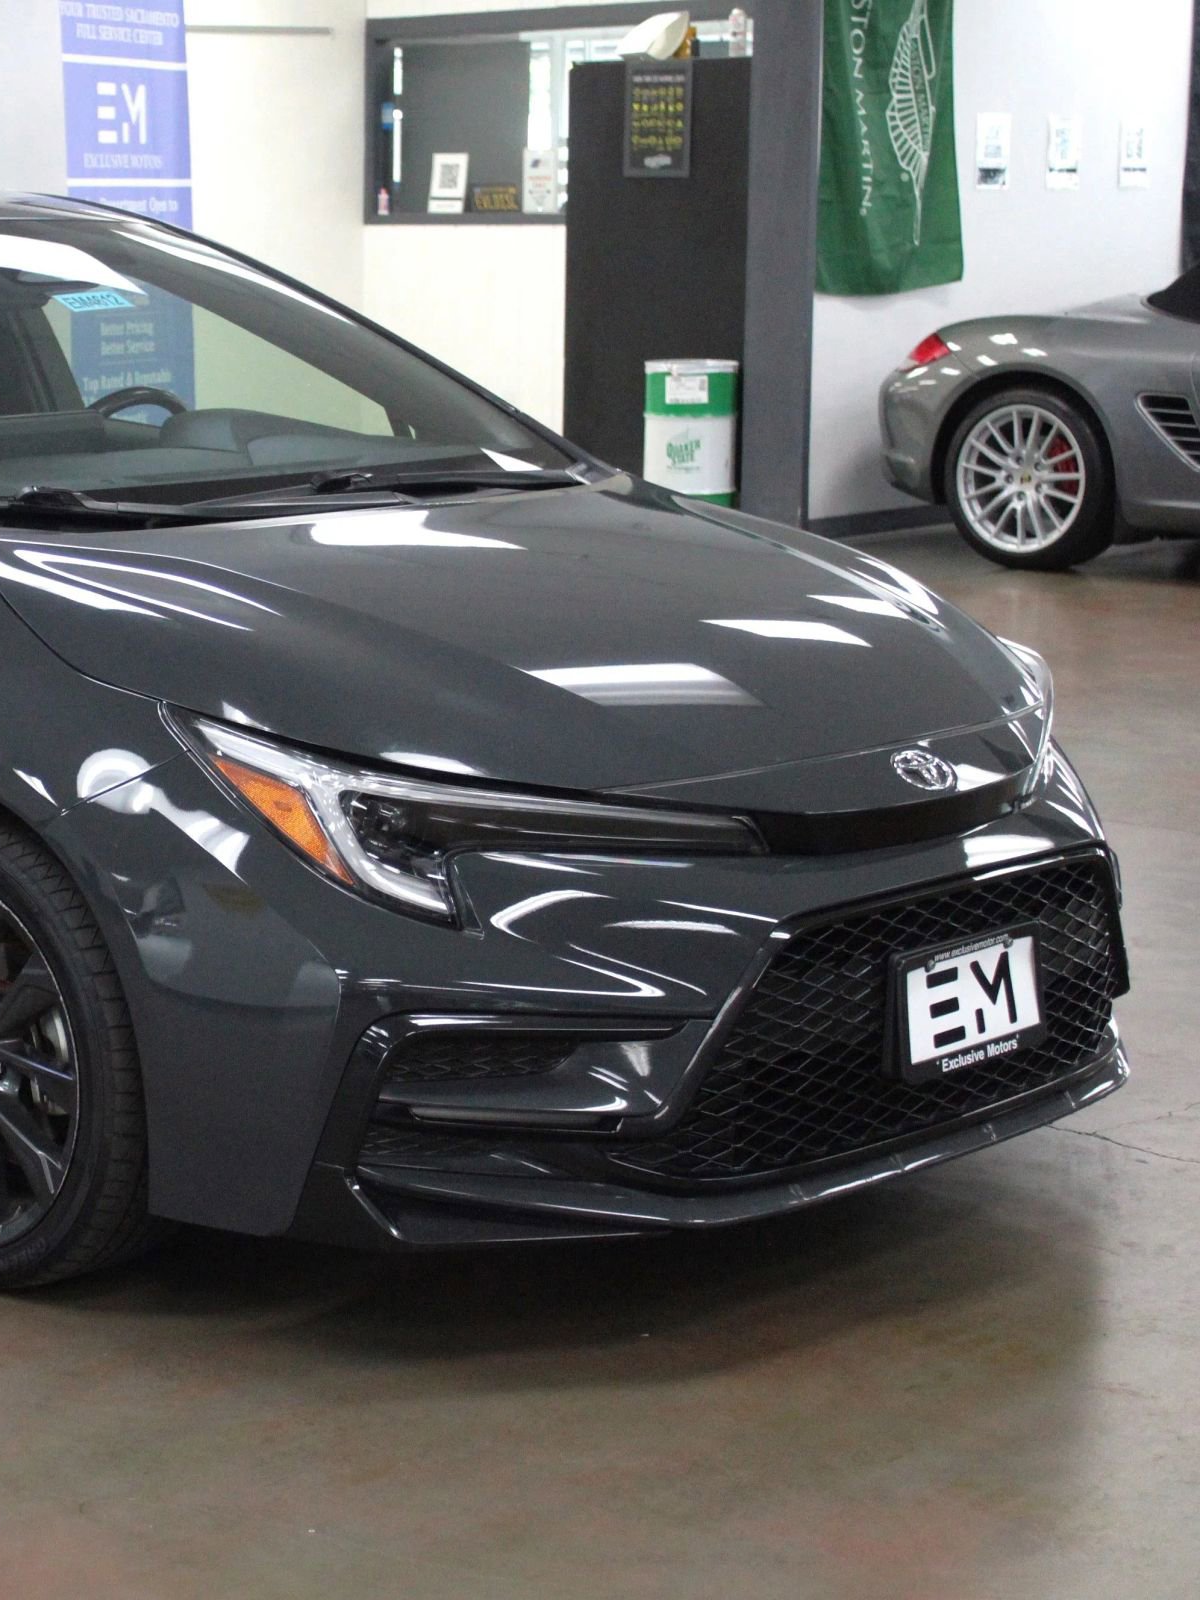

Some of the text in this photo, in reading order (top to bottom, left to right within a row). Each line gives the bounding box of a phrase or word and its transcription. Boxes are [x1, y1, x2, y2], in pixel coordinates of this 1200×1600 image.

[97, 82, 147, 144] EM
[926, 951, 1018, 1049] EM
[942, 1038, 1018, 1073] Exclusive Motors
